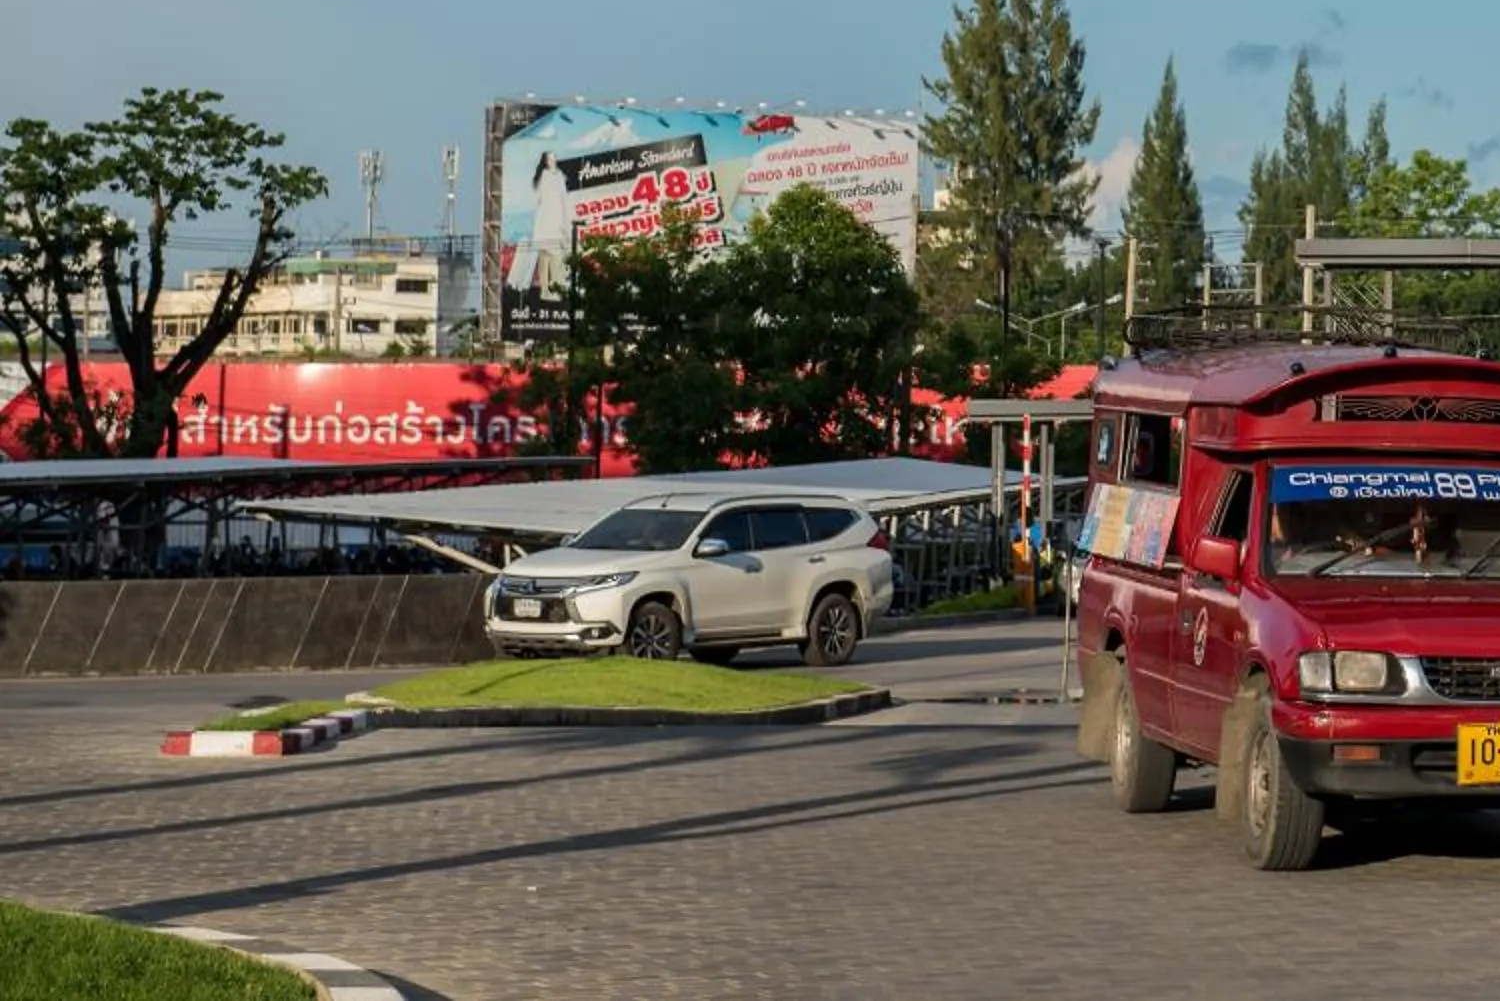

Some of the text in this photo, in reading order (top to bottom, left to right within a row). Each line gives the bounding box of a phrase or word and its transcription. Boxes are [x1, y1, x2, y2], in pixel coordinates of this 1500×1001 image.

[578, 142, 695, 181] American Standard
[632, 169, 690, 204] 48
[1288, 471, 1431, 486] Chiangmai
[1434, 472, 1477, 499] 89
